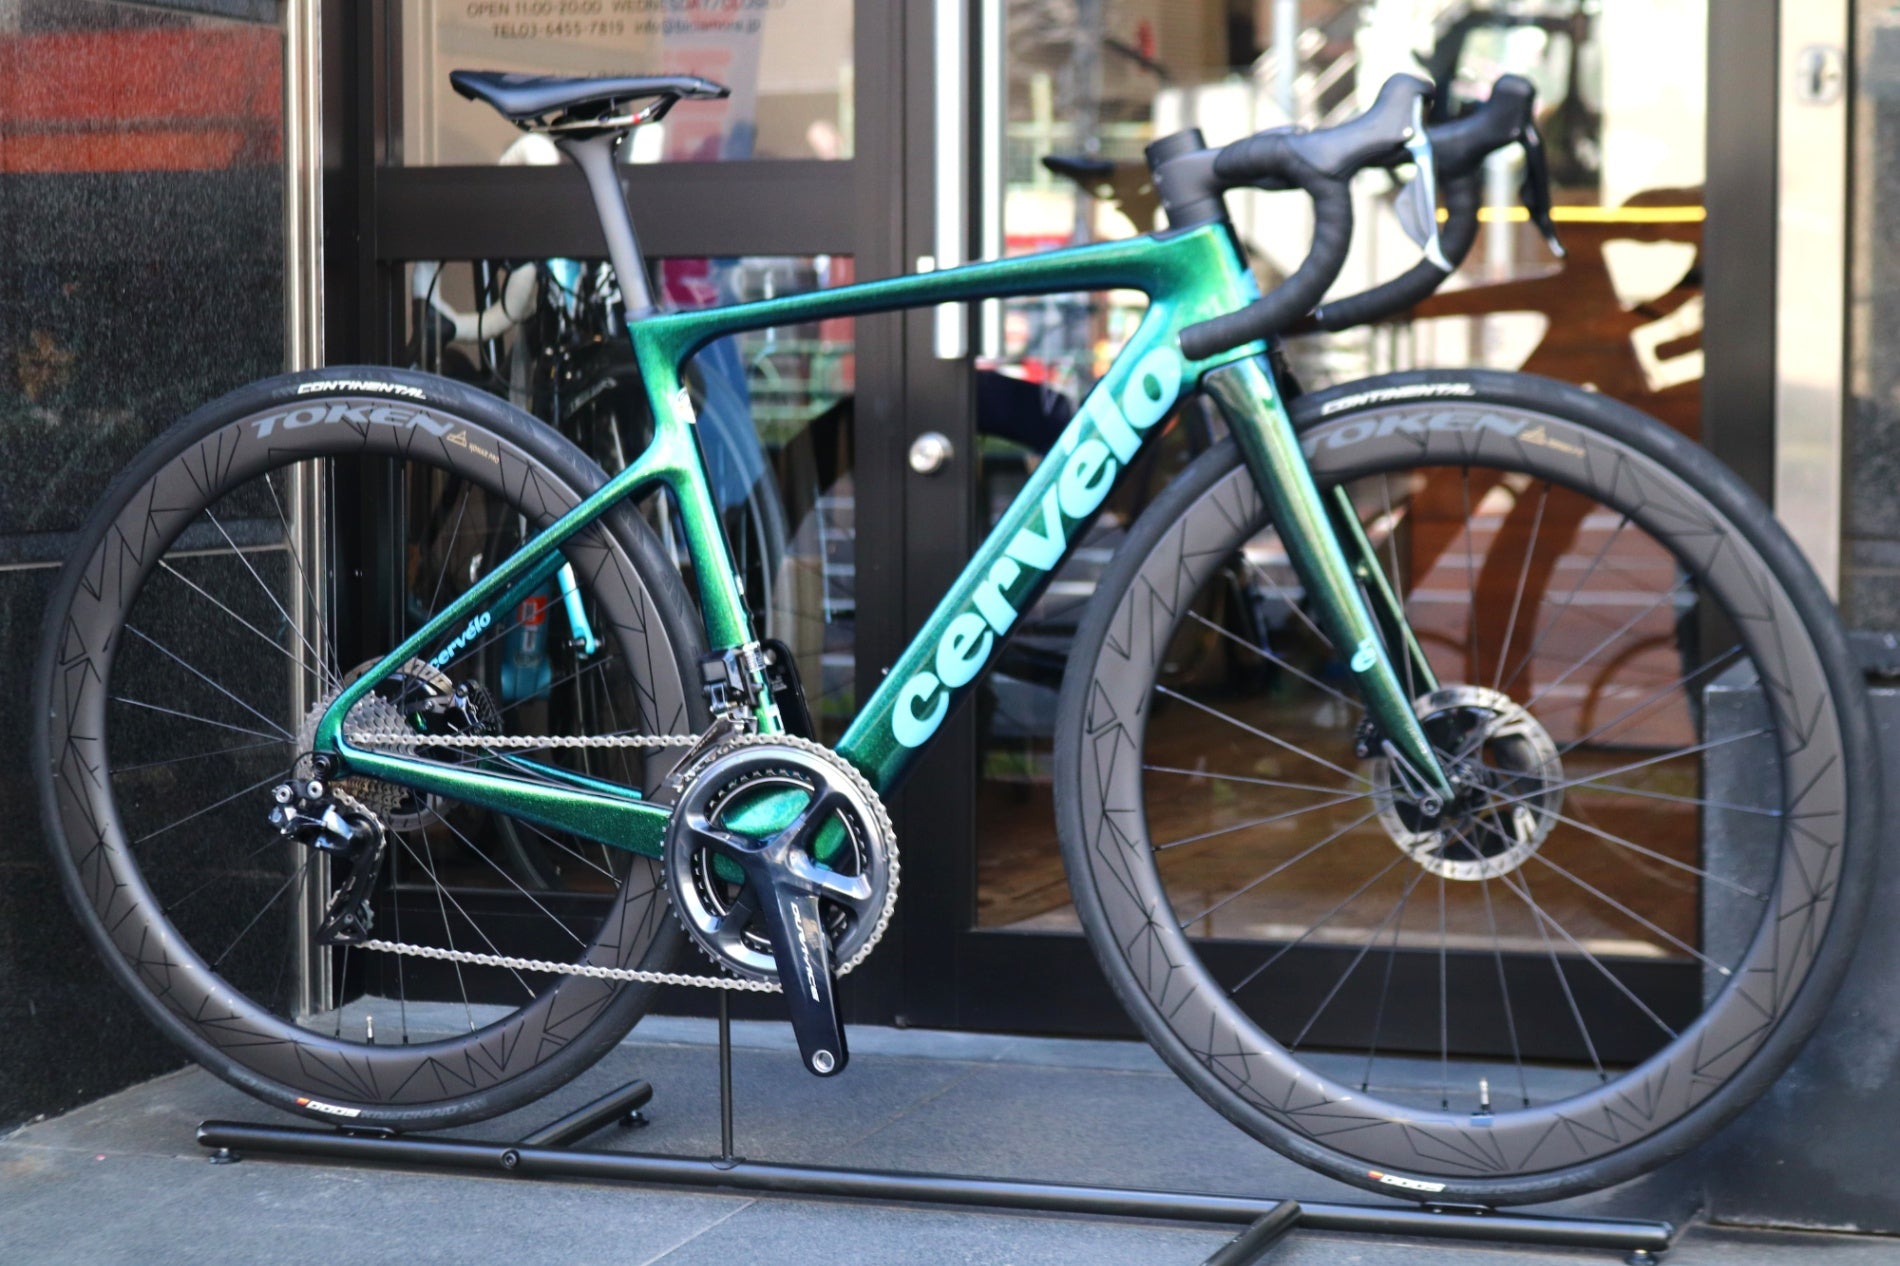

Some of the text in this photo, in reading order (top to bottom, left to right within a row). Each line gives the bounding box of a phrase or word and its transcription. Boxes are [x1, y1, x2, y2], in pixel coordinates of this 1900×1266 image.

[466, 1, 510, 17] OPEN
[297, 380, 427, 400] CONTINENTAL
[1320, 382, 1477, 416] CONTINENTAL
[251, 404, 455, 440] TOKEN
[1301, 410, 1530, 460] TOKEN
[891, 345, 1183, 749] cervélo
